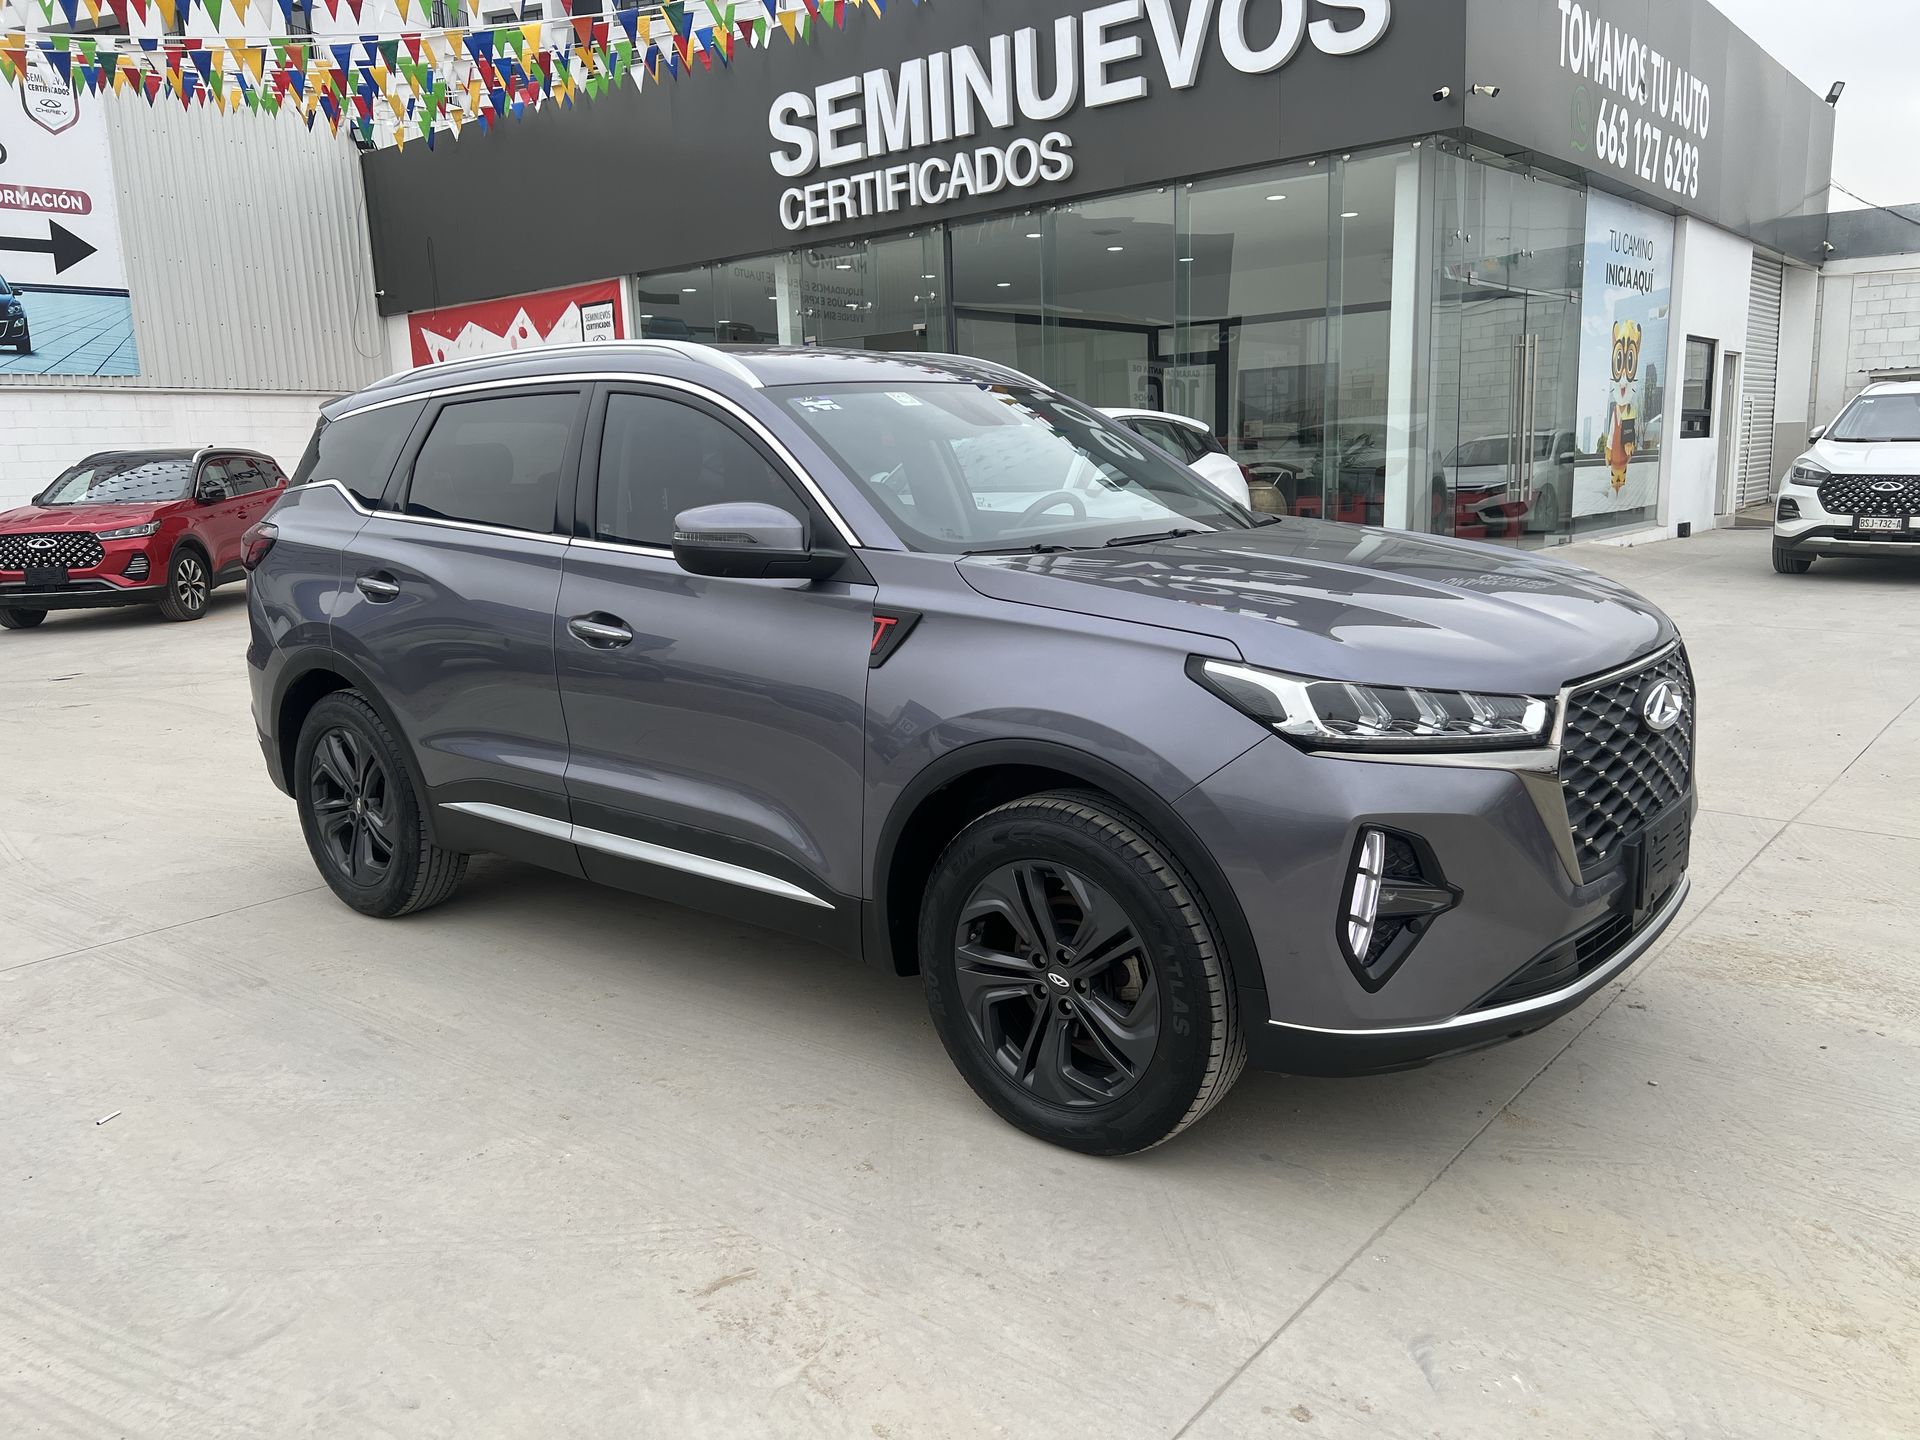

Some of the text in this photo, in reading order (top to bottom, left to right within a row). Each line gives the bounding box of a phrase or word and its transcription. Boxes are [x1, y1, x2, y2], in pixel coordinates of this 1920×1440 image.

[768, 0, 1391, 176] SEMINUEVOS
[1558, 0, 1710, 140] TOMAMOS TU AUTO
[780, 131, 1074, 231] CERTIFICADOS
[1596, 97, 1699, 199] 663 127 6293
[1605, 262, 1655, 296] INICIA AQUÍ
[1609, 229, 1654, 261] TU CAMINO
[1860, 518, 1901, 529] BSJ-732-A
